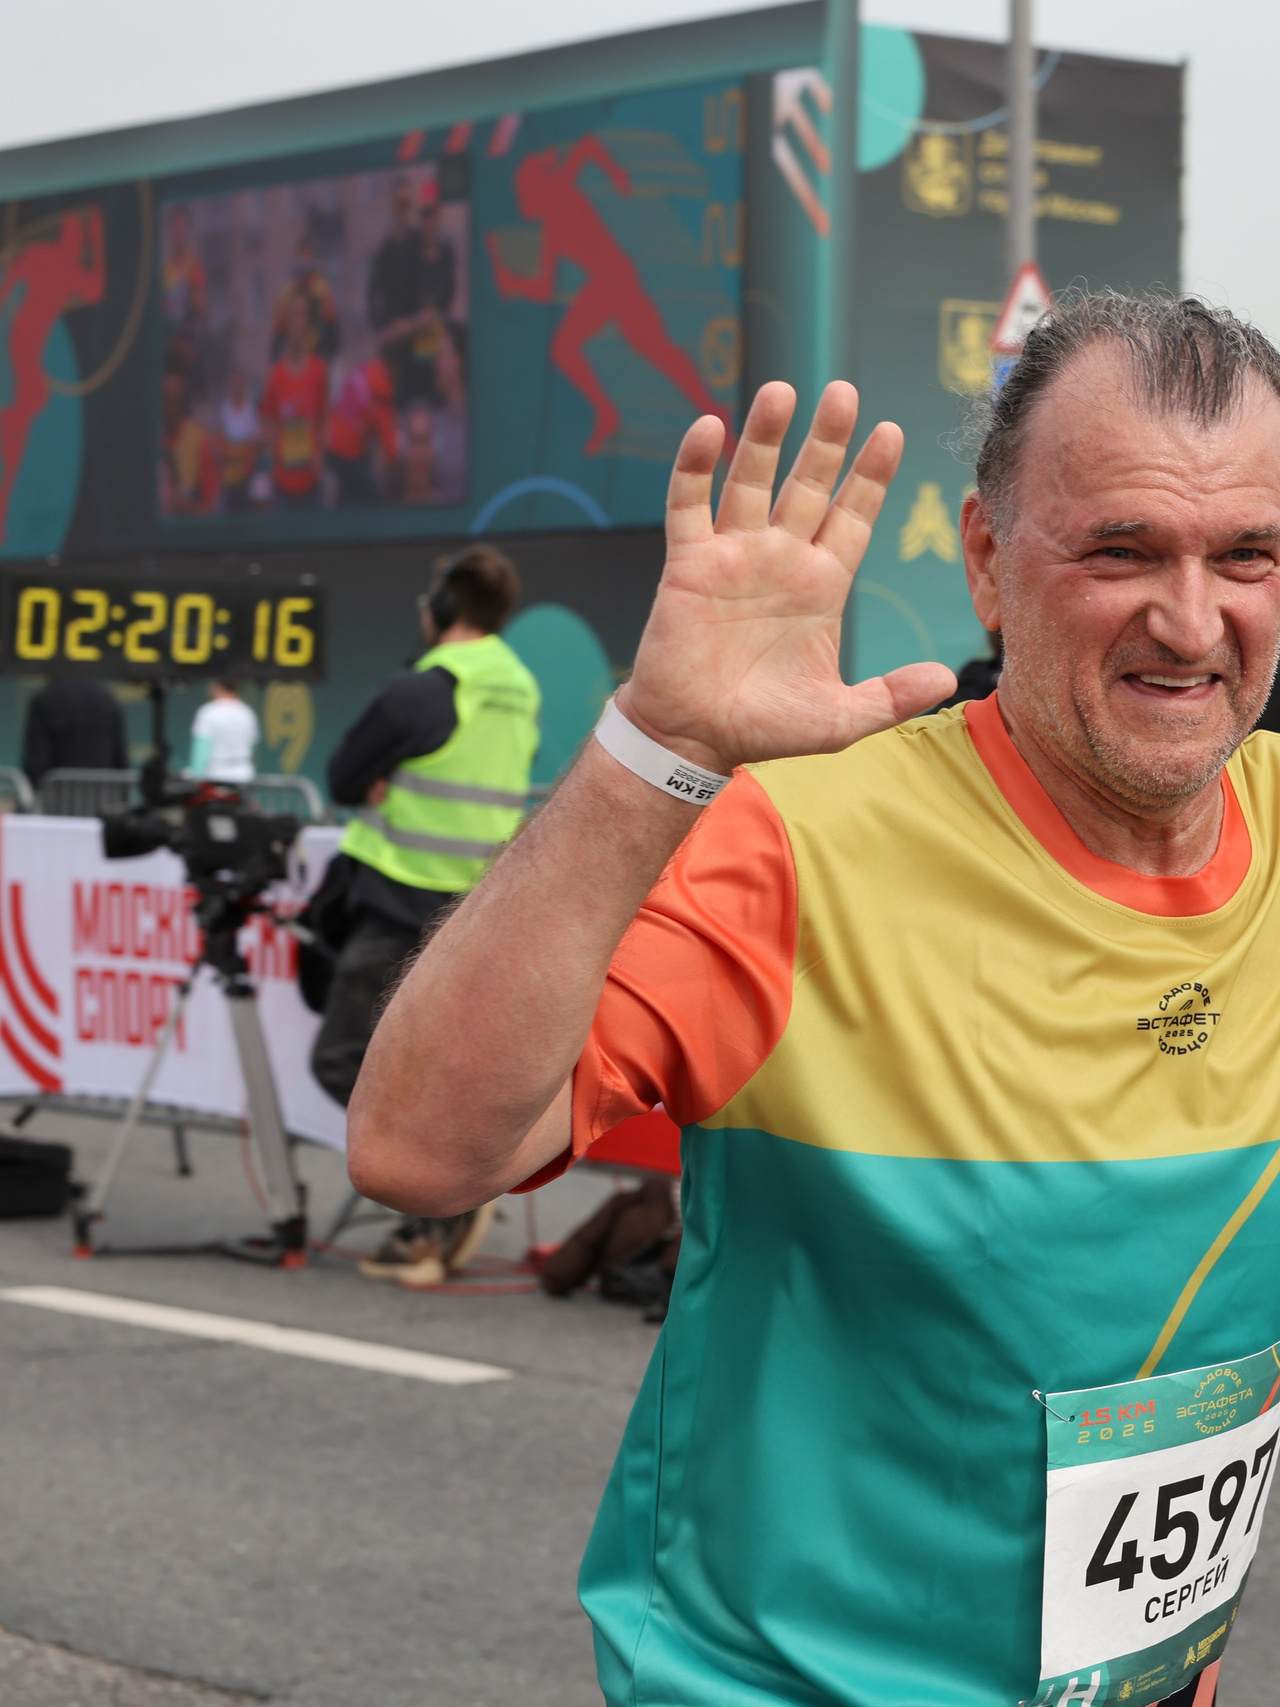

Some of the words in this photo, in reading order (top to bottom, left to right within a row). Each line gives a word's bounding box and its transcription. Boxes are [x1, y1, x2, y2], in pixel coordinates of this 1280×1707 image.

[16, 587, 315, 667] 02:20:16
[695, 788, 716, 800] 15
[1158, 982, 1211, 1011] САДОВОЕ
[1164, 1029, 1194, 1038] 2025
[1194, 1368, 1243, 1399] САДОВОЕ
[1176, 1387, 1254, 1419] ЭСТАФЕТА
[1205, 1408, 1229, 1421] 2025
[1078, 1407, 1111, 1428] 15
[1195, 1408, 1237, 1434] КОЛЬЦО
[1077, 1419, 1156, 1445] 2025
[1084, 1426, 1280, 1593] 4597
[1144, 1554, 1230, 1625] СЕРГЕЙ
